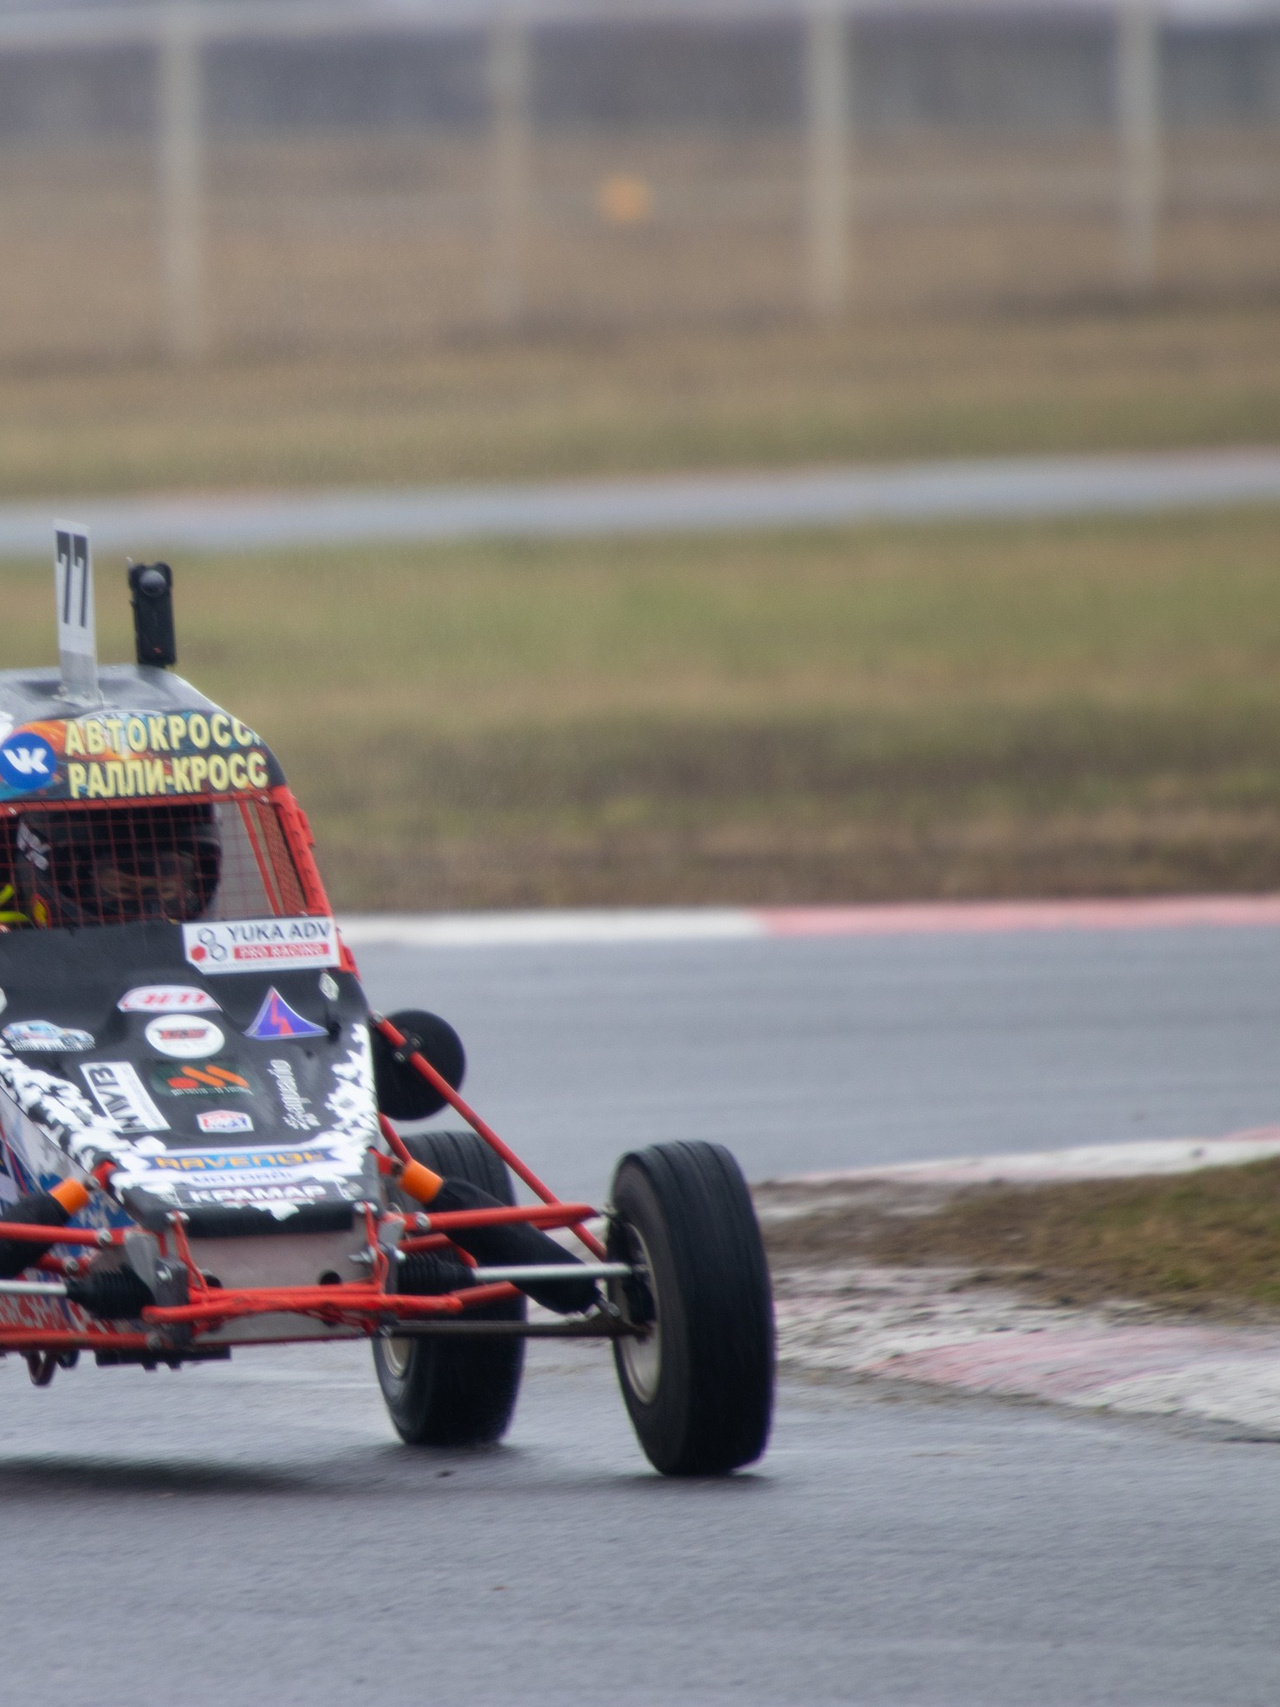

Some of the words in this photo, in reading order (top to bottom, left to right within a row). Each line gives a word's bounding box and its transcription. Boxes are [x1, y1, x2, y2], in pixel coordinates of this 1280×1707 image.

[55, 529, 88, 629] 77
[65, 713, 253, 757] АВТОКРОСС
[69, 751, 269, 799] РАЛЛИ-КРОСС
[226, 923, 284, 942] YUKA
[289, 921, 331, 940] ADV
[238, 946, 268, 959] PRO
[271, 944, 324, 958] RACING
[155, 1151, 325, 1171] RAVENOL
